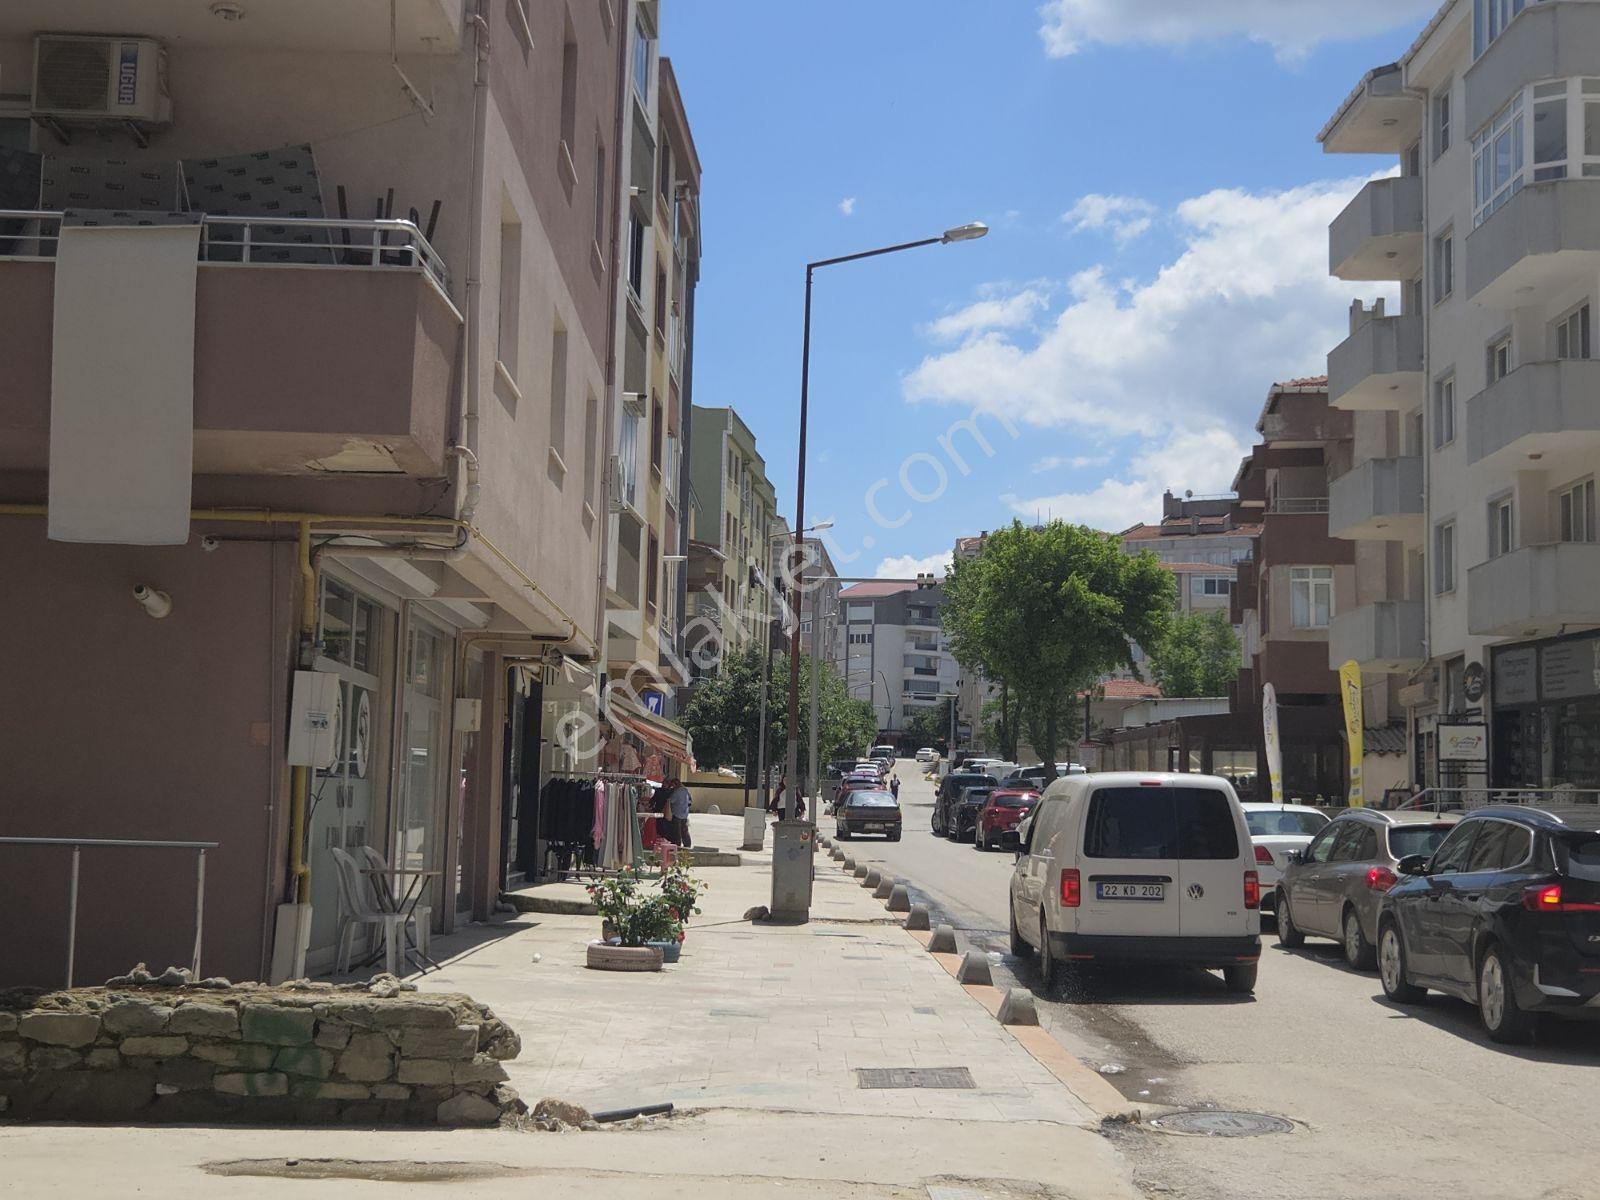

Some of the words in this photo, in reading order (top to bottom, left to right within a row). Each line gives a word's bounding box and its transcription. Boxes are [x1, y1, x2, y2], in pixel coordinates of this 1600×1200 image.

[1104, 885, 1118, 896] 22
[1123, 885, 1136, 896] KD
[1142, 886, 1161, 896] 202
